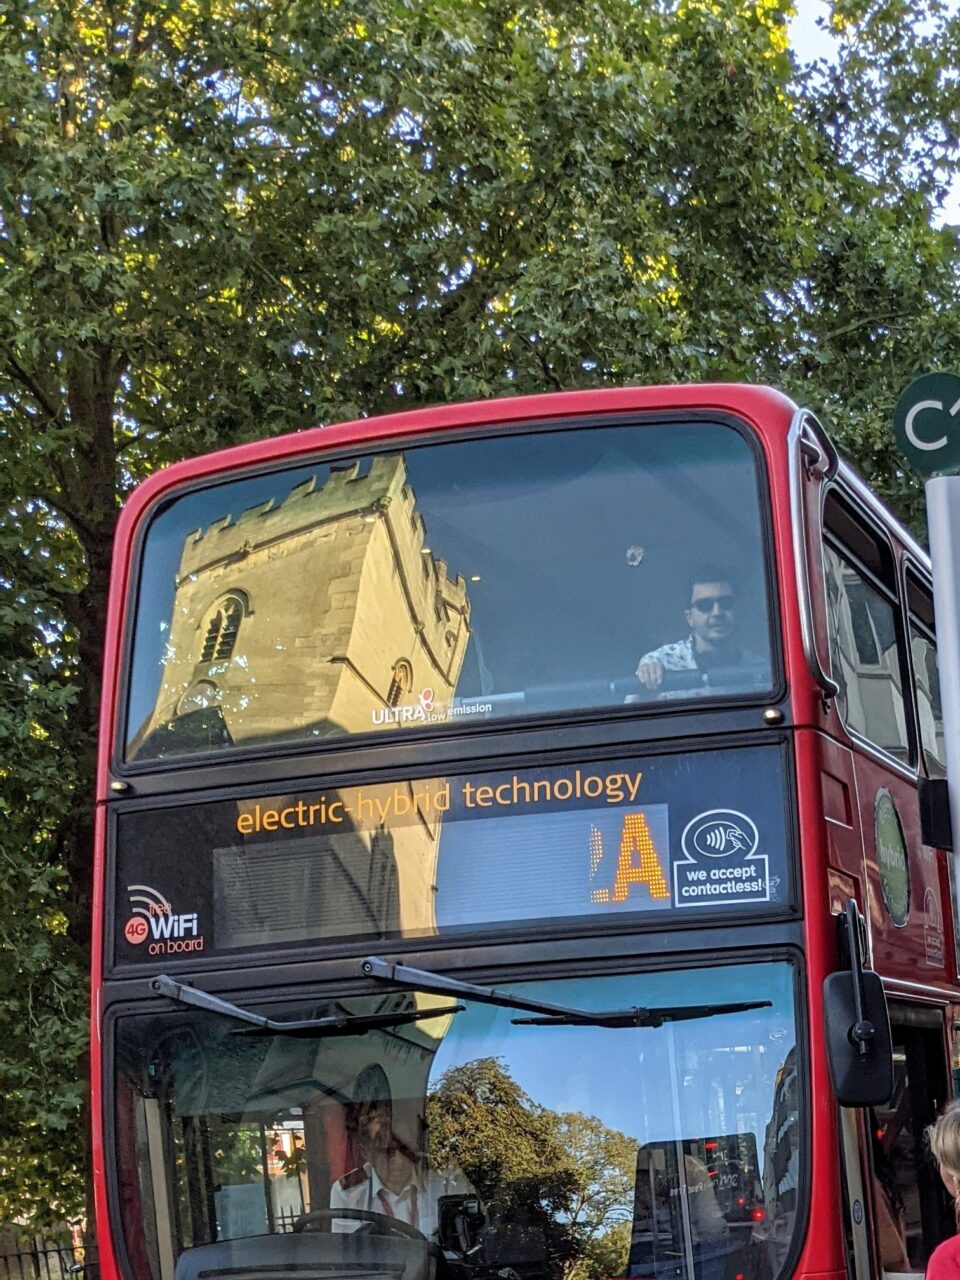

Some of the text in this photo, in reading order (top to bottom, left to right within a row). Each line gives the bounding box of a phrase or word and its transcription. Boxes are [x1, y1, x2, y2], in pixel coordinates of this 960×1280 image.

[371, 703, 492, 725] ULTRA low emission
[236, 771, 643, 835] electric-hybrid technology
[687, 865, 756, 881] we accept
[681, 879, 762, 897] contactless!
[127, 913, 198, 939] 4G WiFi
[149, 936, 204, 955] on board
